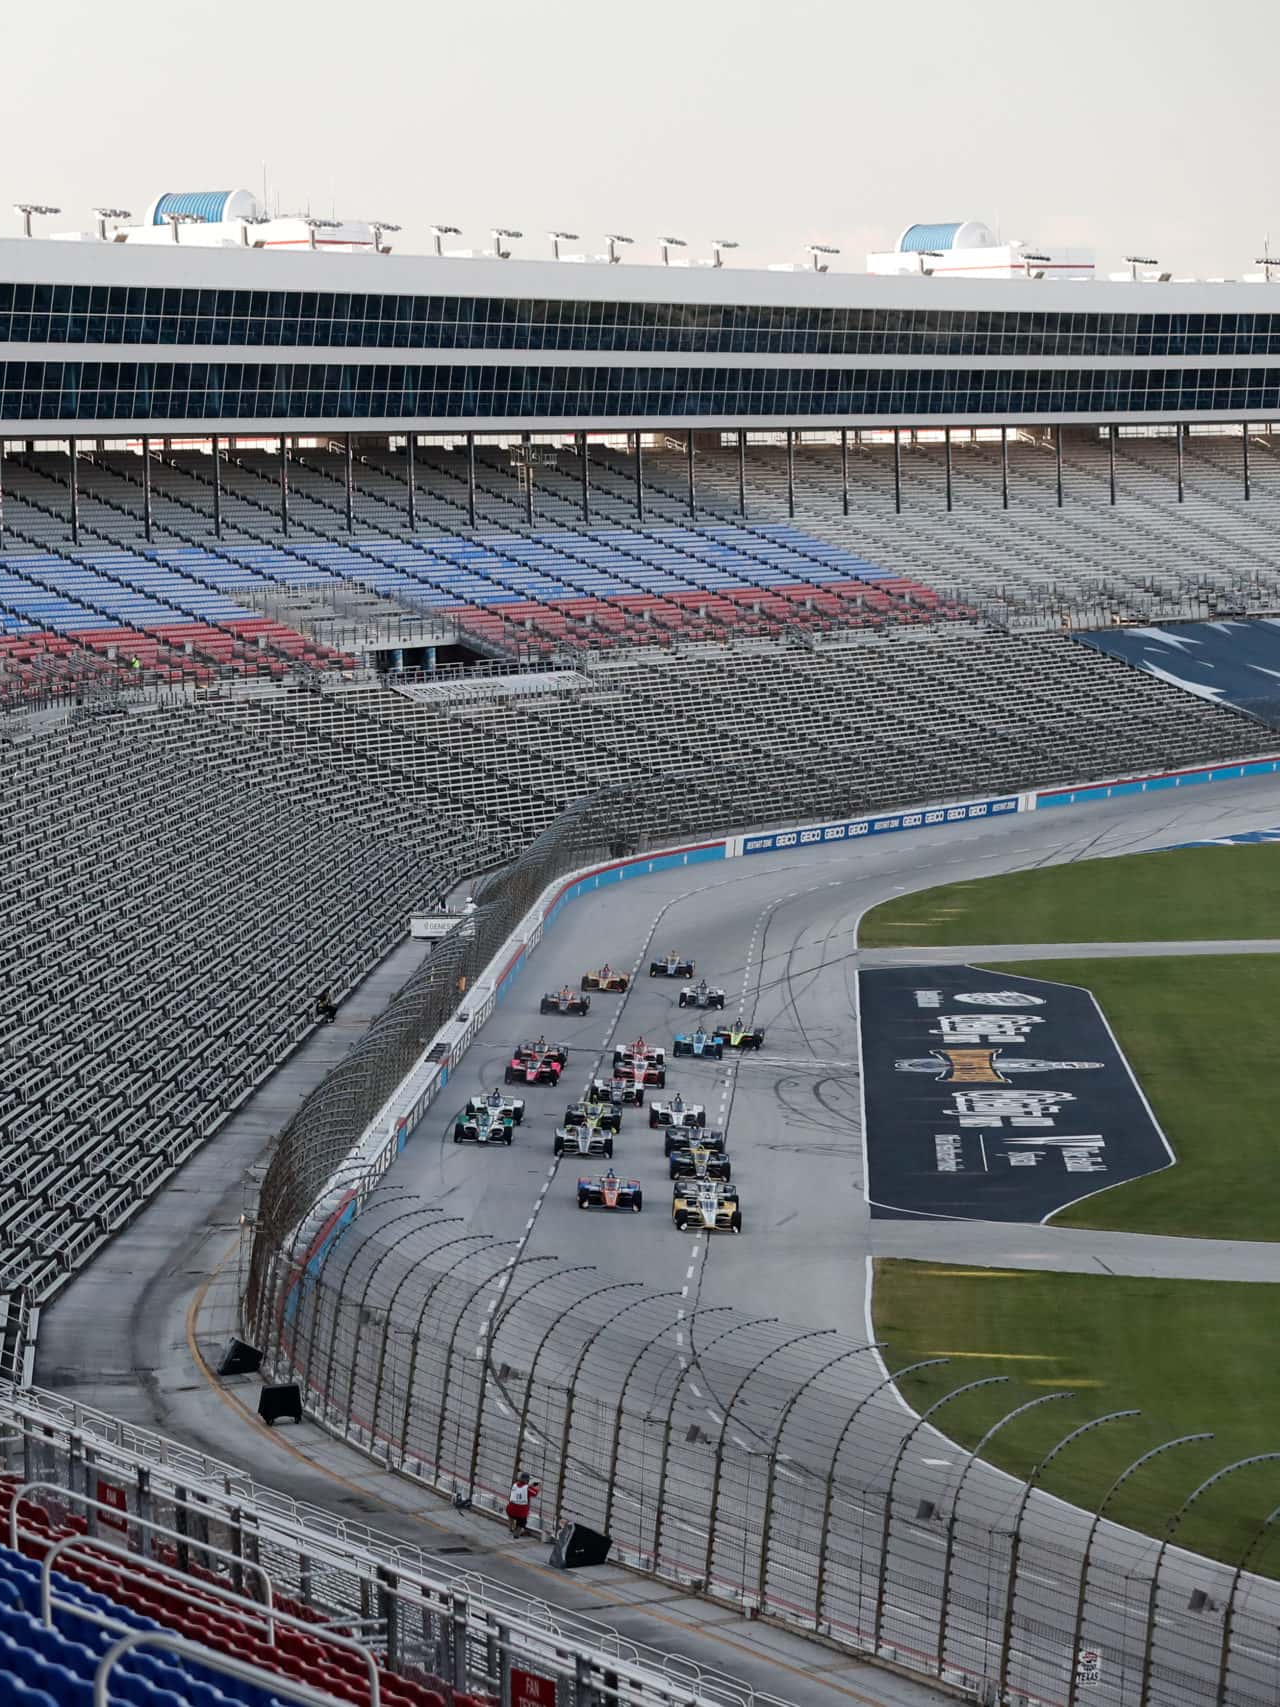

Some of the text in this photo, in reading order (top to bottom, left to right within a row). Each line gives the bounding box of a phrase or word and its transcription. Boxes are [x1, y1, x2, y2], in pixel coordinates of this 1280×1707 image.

[776, 833, 797, 847] GEICO
[800, 830, 821, 843] GEICO
[824, 826, 845, 839] GEICO
[848, 823, 868, 836] GEICO
[902, 814, 922, 827] GEICO
[925, 811, 945, 824] GEICO
[947, 808, 966, 820] GEICO
[968, 804, 988, 817] GEICO
[474, 998, 494, 1033] TEXAS
[452, 1029, 471, 1068] TEXAS
[525, 1676, 539, 1696] FAN
[1076, 1672, 1098, 1681] TEXAS
